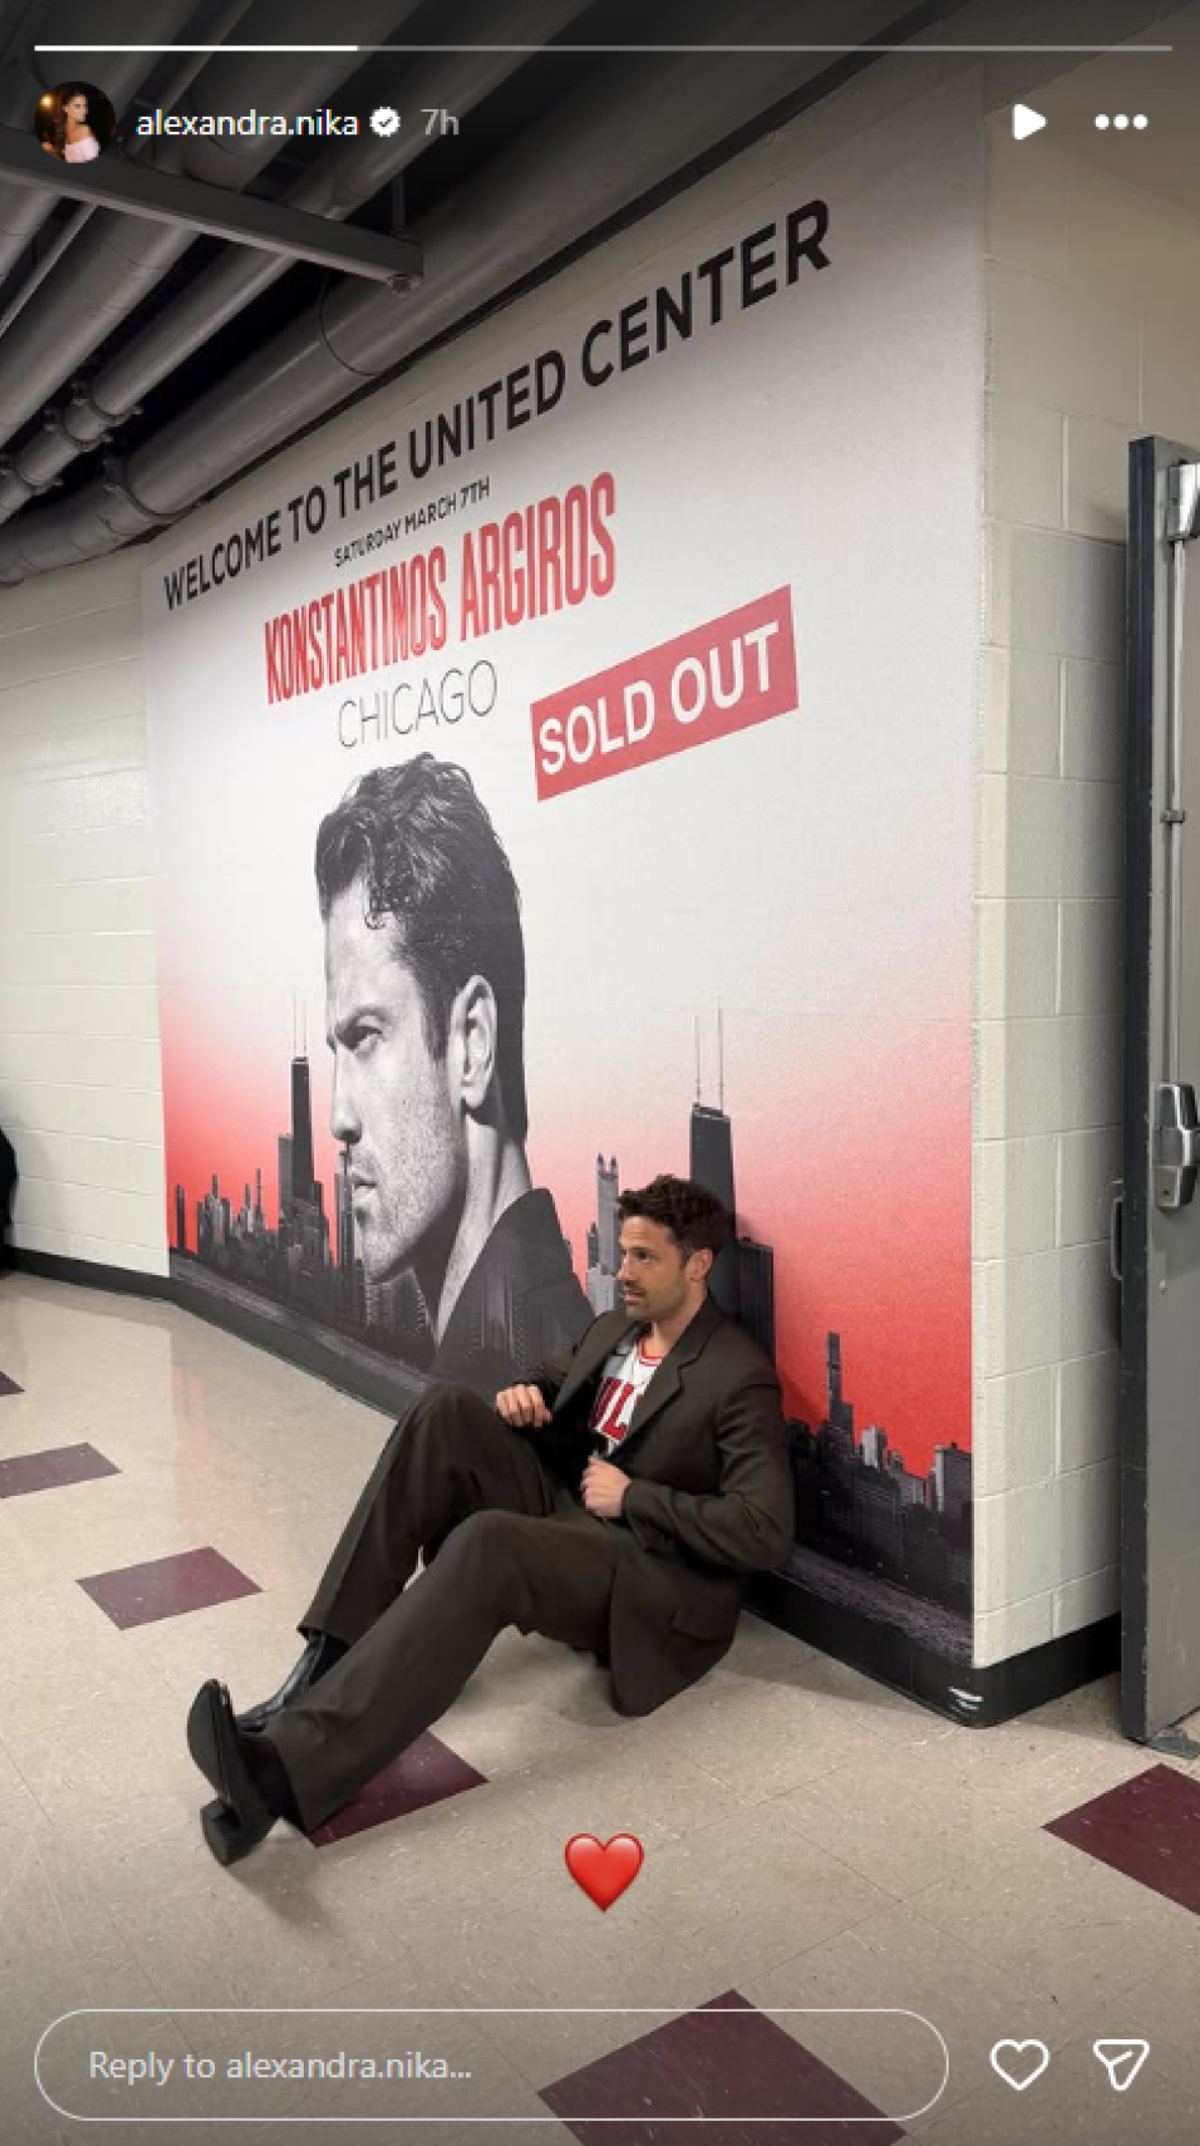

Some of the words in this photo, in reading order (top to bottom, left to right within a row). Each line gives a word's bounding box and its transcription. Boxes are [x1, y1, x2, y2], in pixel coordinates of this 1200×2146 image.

[164, 510, 281, 611] WELCOME
[288, 485, 327, 543] TO
[334, 441, 398, 518] THE
[409, 350, 566, 479] UNITED
[581, 199, 832, 388] CENTER
[264, 545, 447, 704] KONSTANTINOS
[460, 471, 616, 641] ARGIROS
[334, 518, 401, 567] SATURDAY
[404, 492, 457, 534] MARCH
[460, 475, 490, 508] 7TH
[339, 660, 498, 748] CHICAGO
[539, 680, 655, 775] SOLD
[670, 622, 779, 724] OUT
